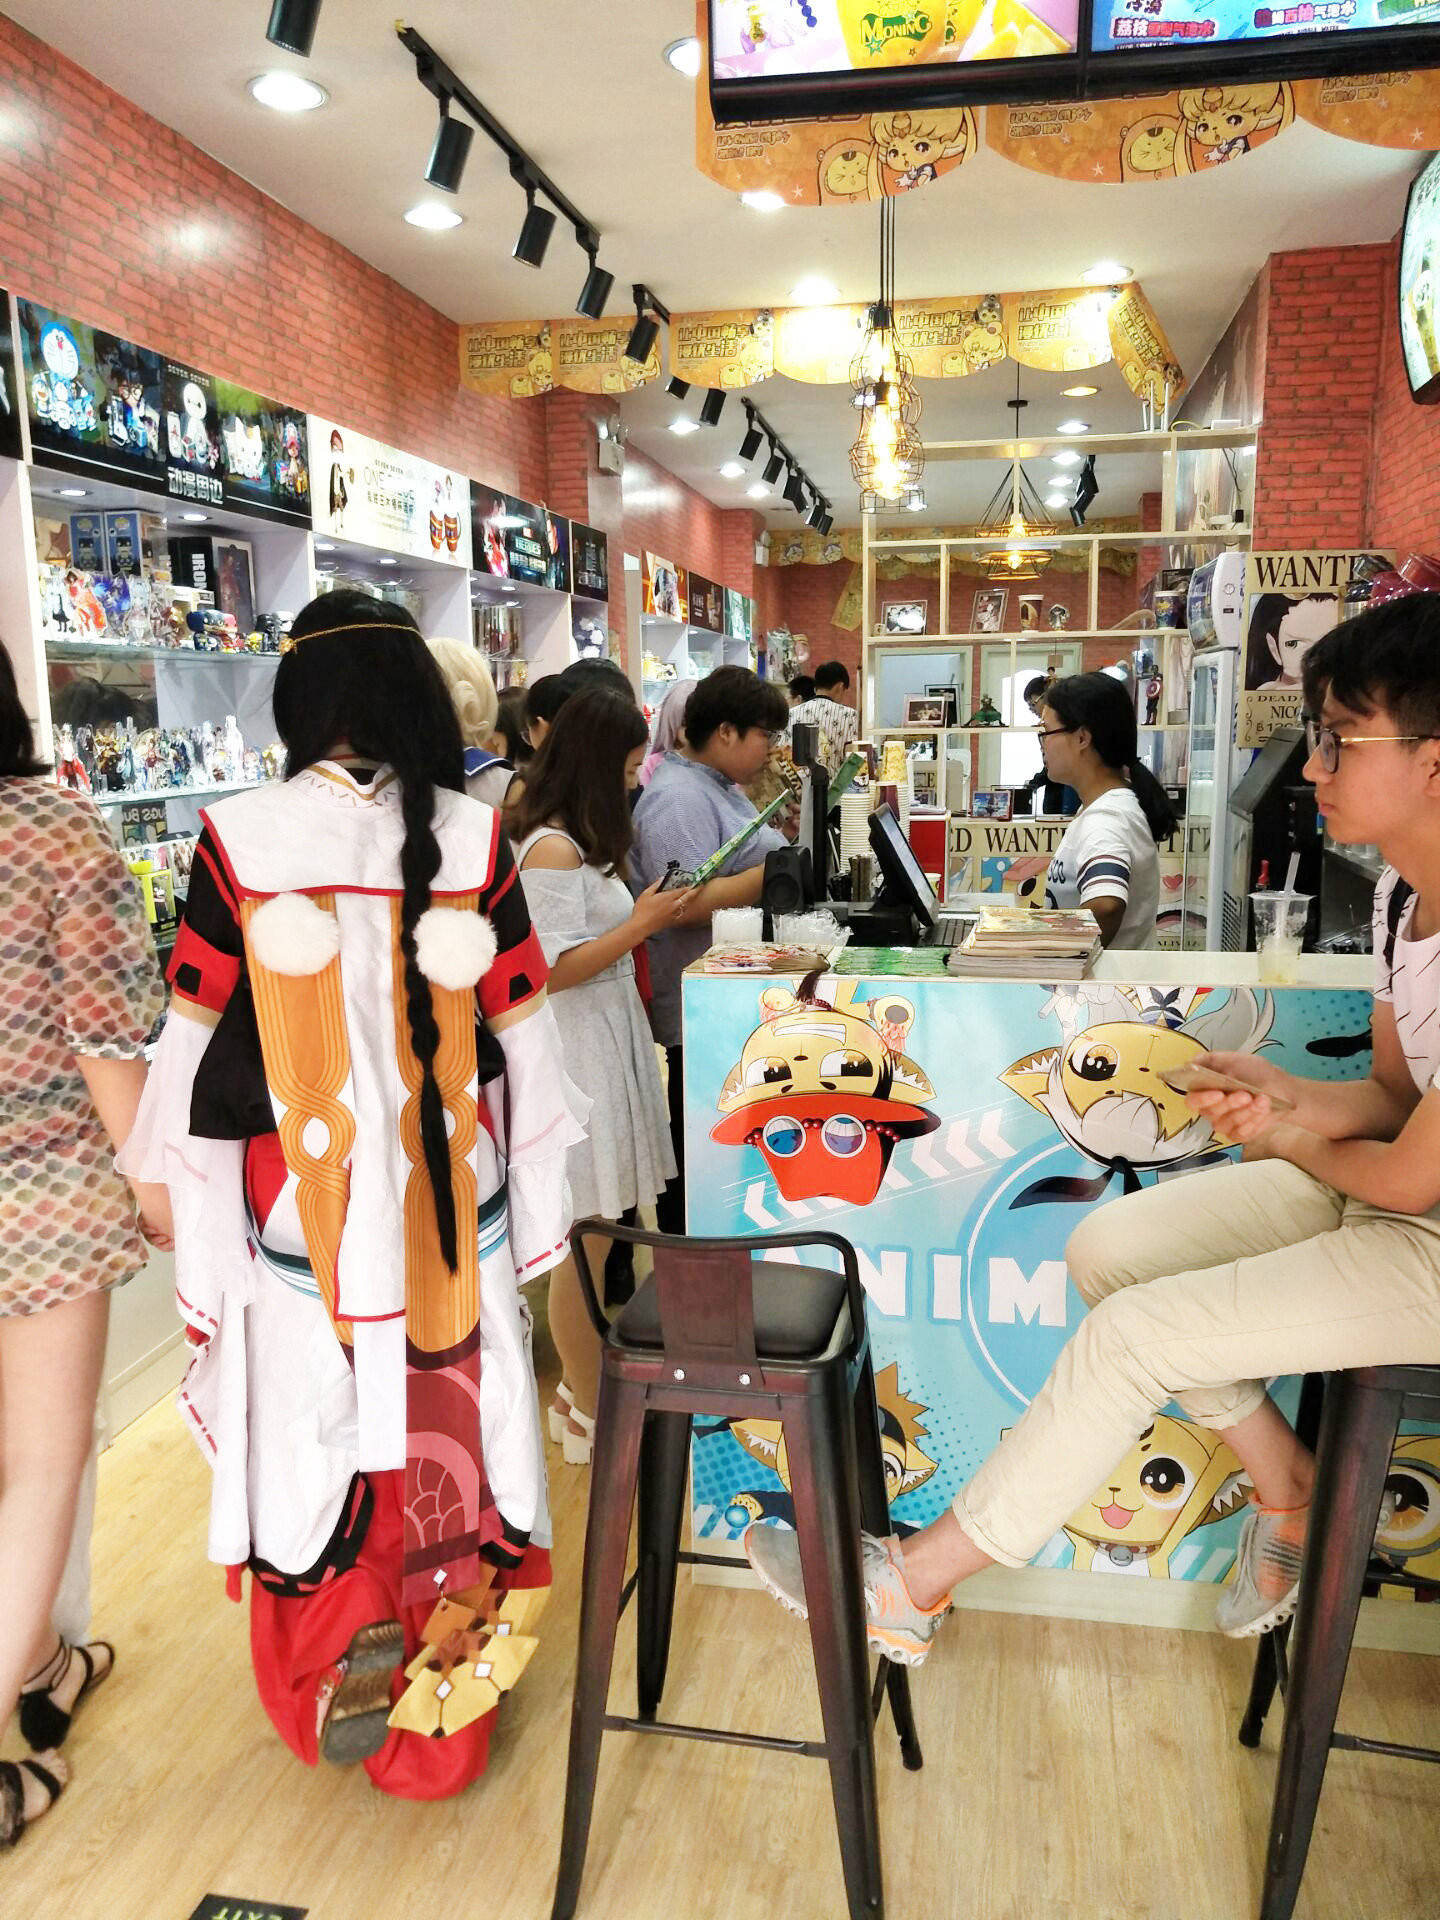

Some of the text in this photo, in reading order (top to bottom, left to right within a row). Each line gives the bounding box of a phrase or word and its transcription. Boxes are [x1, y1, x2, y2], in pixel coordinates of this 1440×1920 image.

[167, 466, 224, 504] 动漫周边
[1258, 695, 1297, 703] DEAD
